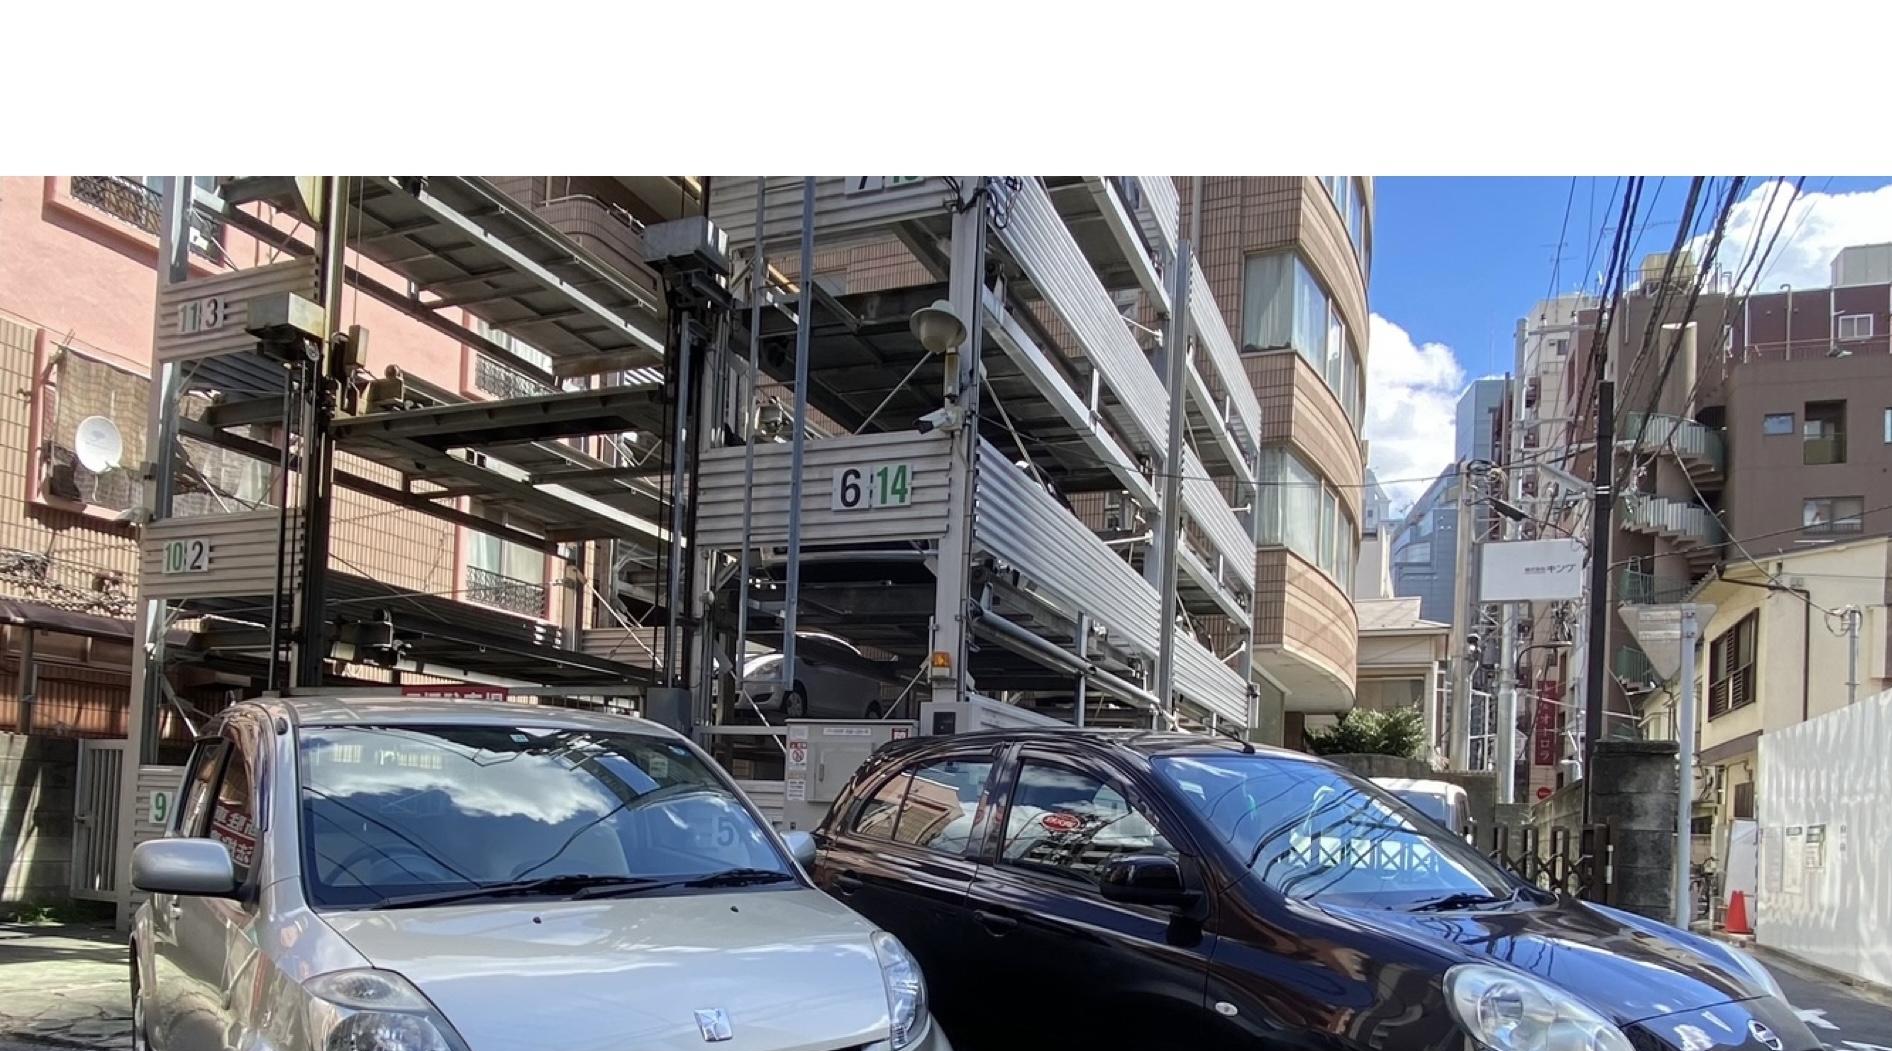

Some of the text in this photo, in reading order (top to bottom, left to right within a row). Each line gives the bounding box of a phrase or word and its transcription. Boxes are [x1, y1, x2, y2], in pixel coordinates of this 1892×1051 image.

[180, 298, 218, 332] 11 3
[841, 465, 908, 507] 6 14
[166, 540, 204, 572] 10 2
[154, 792, 167, 821] 9
